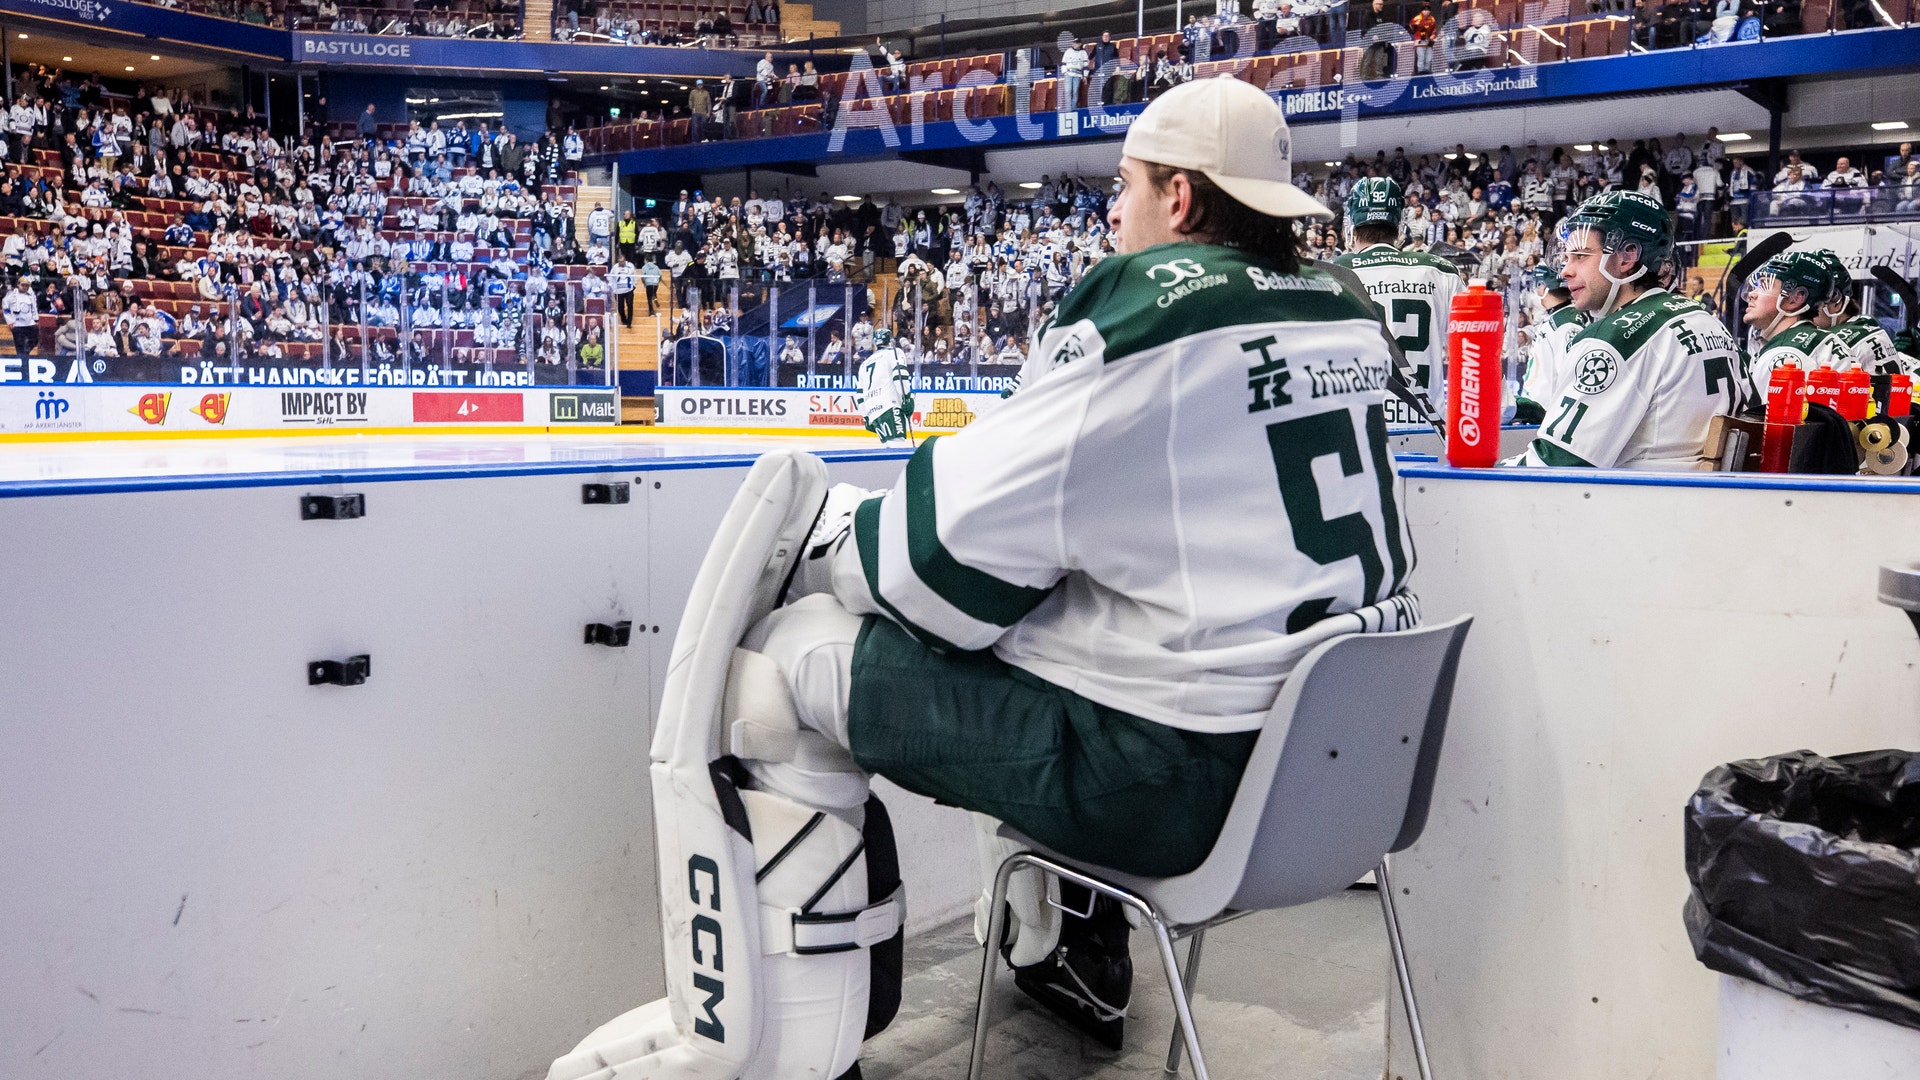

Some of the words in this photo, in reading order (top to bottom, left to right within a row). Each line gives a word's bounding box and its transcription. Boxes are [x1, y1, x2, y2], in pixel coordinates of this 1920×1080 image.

[305, 40, 411, 57] BASTULOGE
[827, 30, 1140, 152] Arctic
[1194, 0, 1573, 147] Paper
[1412, 81, 1472, 99] Leksands
[1475, 75, 1538, 96] Sparbank
[1286, 90, 1344, 114] RÖRELSE
[1083, 116, 1098, 128] LF
[1372, 191, 1385, 202] 92
[1622, 191, 1660, 210] Lecab
[1631, 221, 1657, 234] CCM
[1351, 256, 1419, 268] Schaktmiljö
[1374, 299, 1431, 389] 2
[181, 361, 243, 385] RÄTT
[411, 364, 468, 386] RÄTT
[796, 371, 829, 389] RÄTT
[909, 373, 932, 391] ÖR
[935, 371, 973, 391] RÄTT
[866, 362, 876, 390] 7
[1303, 357, 1389, 399] Infrakra
[1460, 337, 1481, 419] ENERVIT
[281, 392, 343, 416] IMPACT
[346, 392, 367, 415] BY
[680, 397, 787, 416] OPTILEKS
[933, 398, 963, 413] EURO
[316, 417, 334, 425] SHL
[923, 412, 976, 428] JACKPOT
[1546, 395, 1588, 444] 71
[688, 853, 726, 1044] CCM
